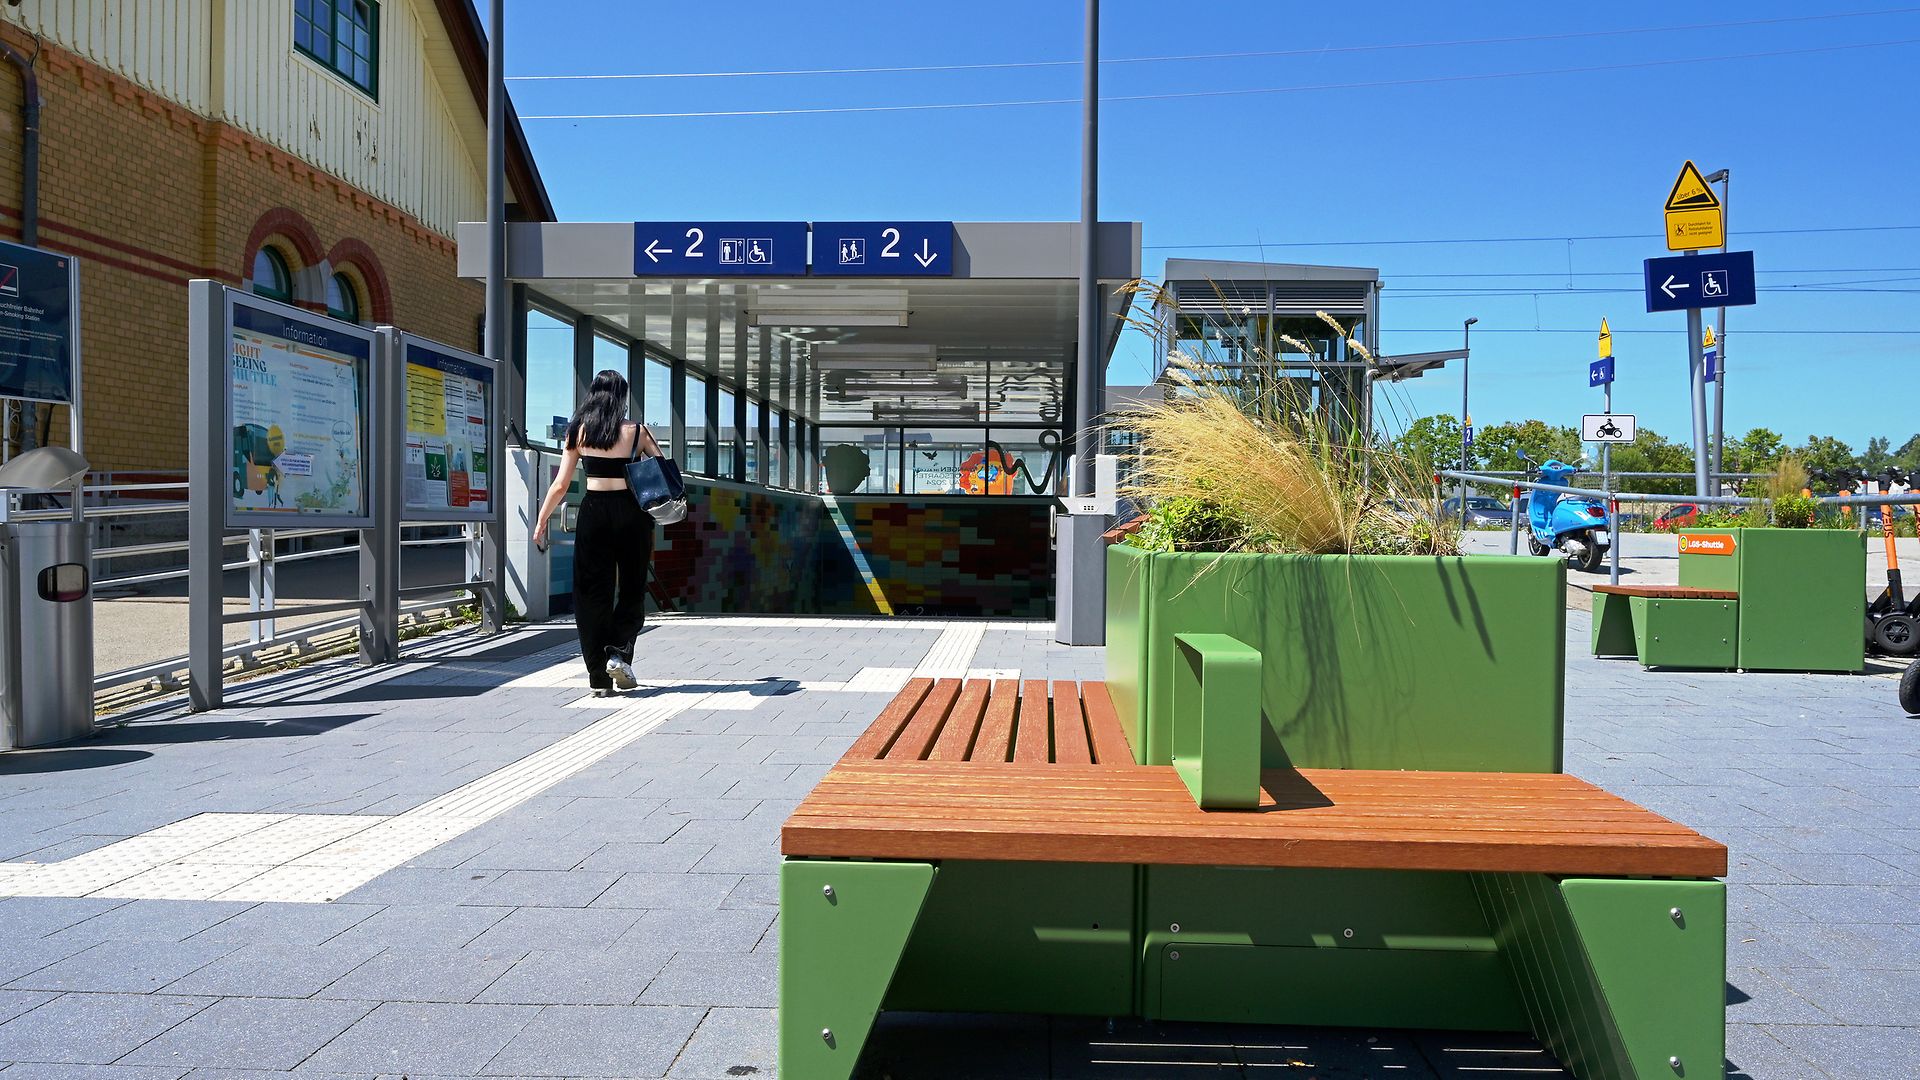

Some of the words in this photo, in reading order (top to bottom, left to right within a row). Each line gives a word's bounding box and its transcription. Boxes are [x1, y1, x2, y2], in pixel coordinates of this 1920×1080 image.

[1677, 192, 1690, 200] über
[685, 228, 704, 258] 2
[880, 228, 900, 258] 2
[23, 305, 44, 315] Bahnhof
[282, 322, 328, 347] Information
[233, 342, 261, 359] IGHT
[1466, 429, 1471, 442] 2
[1882, 511, 1893, 538] ZEUS
[1688, 540, 1725, 549] LGS-Shuttle
